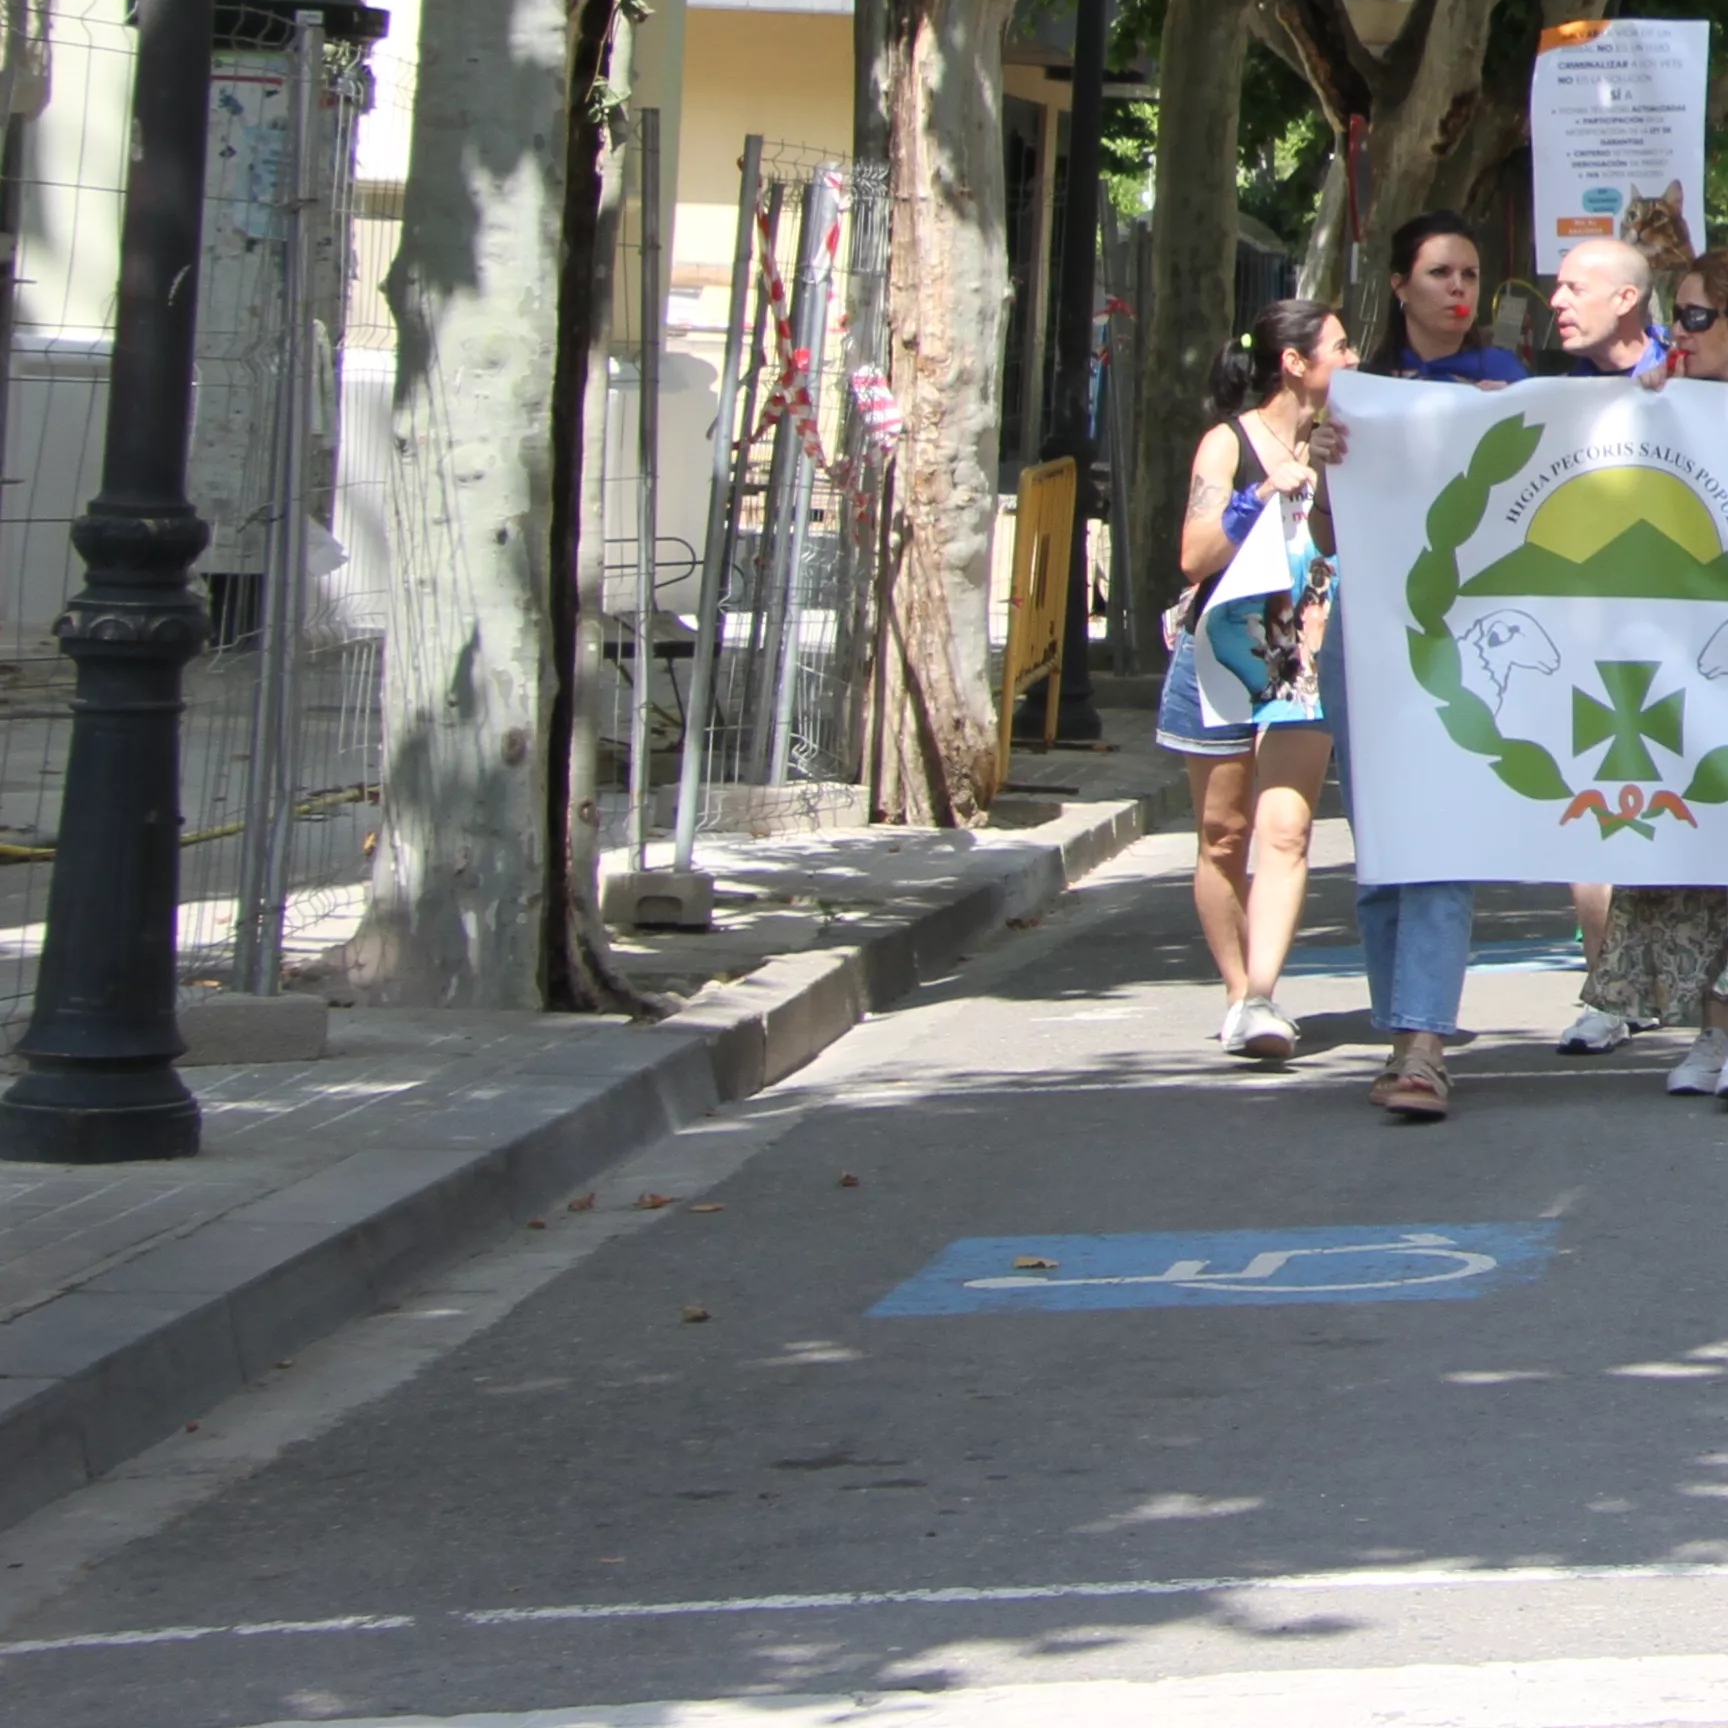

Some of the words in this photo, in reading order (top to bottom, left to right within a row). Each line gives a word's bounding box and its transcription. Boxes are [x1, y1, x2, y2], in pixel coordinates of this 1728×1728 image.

[1597, 44, 1614, 53] NO
[1557, 60, 1629, 70] CRIMINALIZAR
[1557, 75, 1574, 85] NO
[1505, 473, 1551, 525] HIGIA
[1550, 442, 1635, 477] PECORIS
[1638, 441, 1696, 474] SALUS
